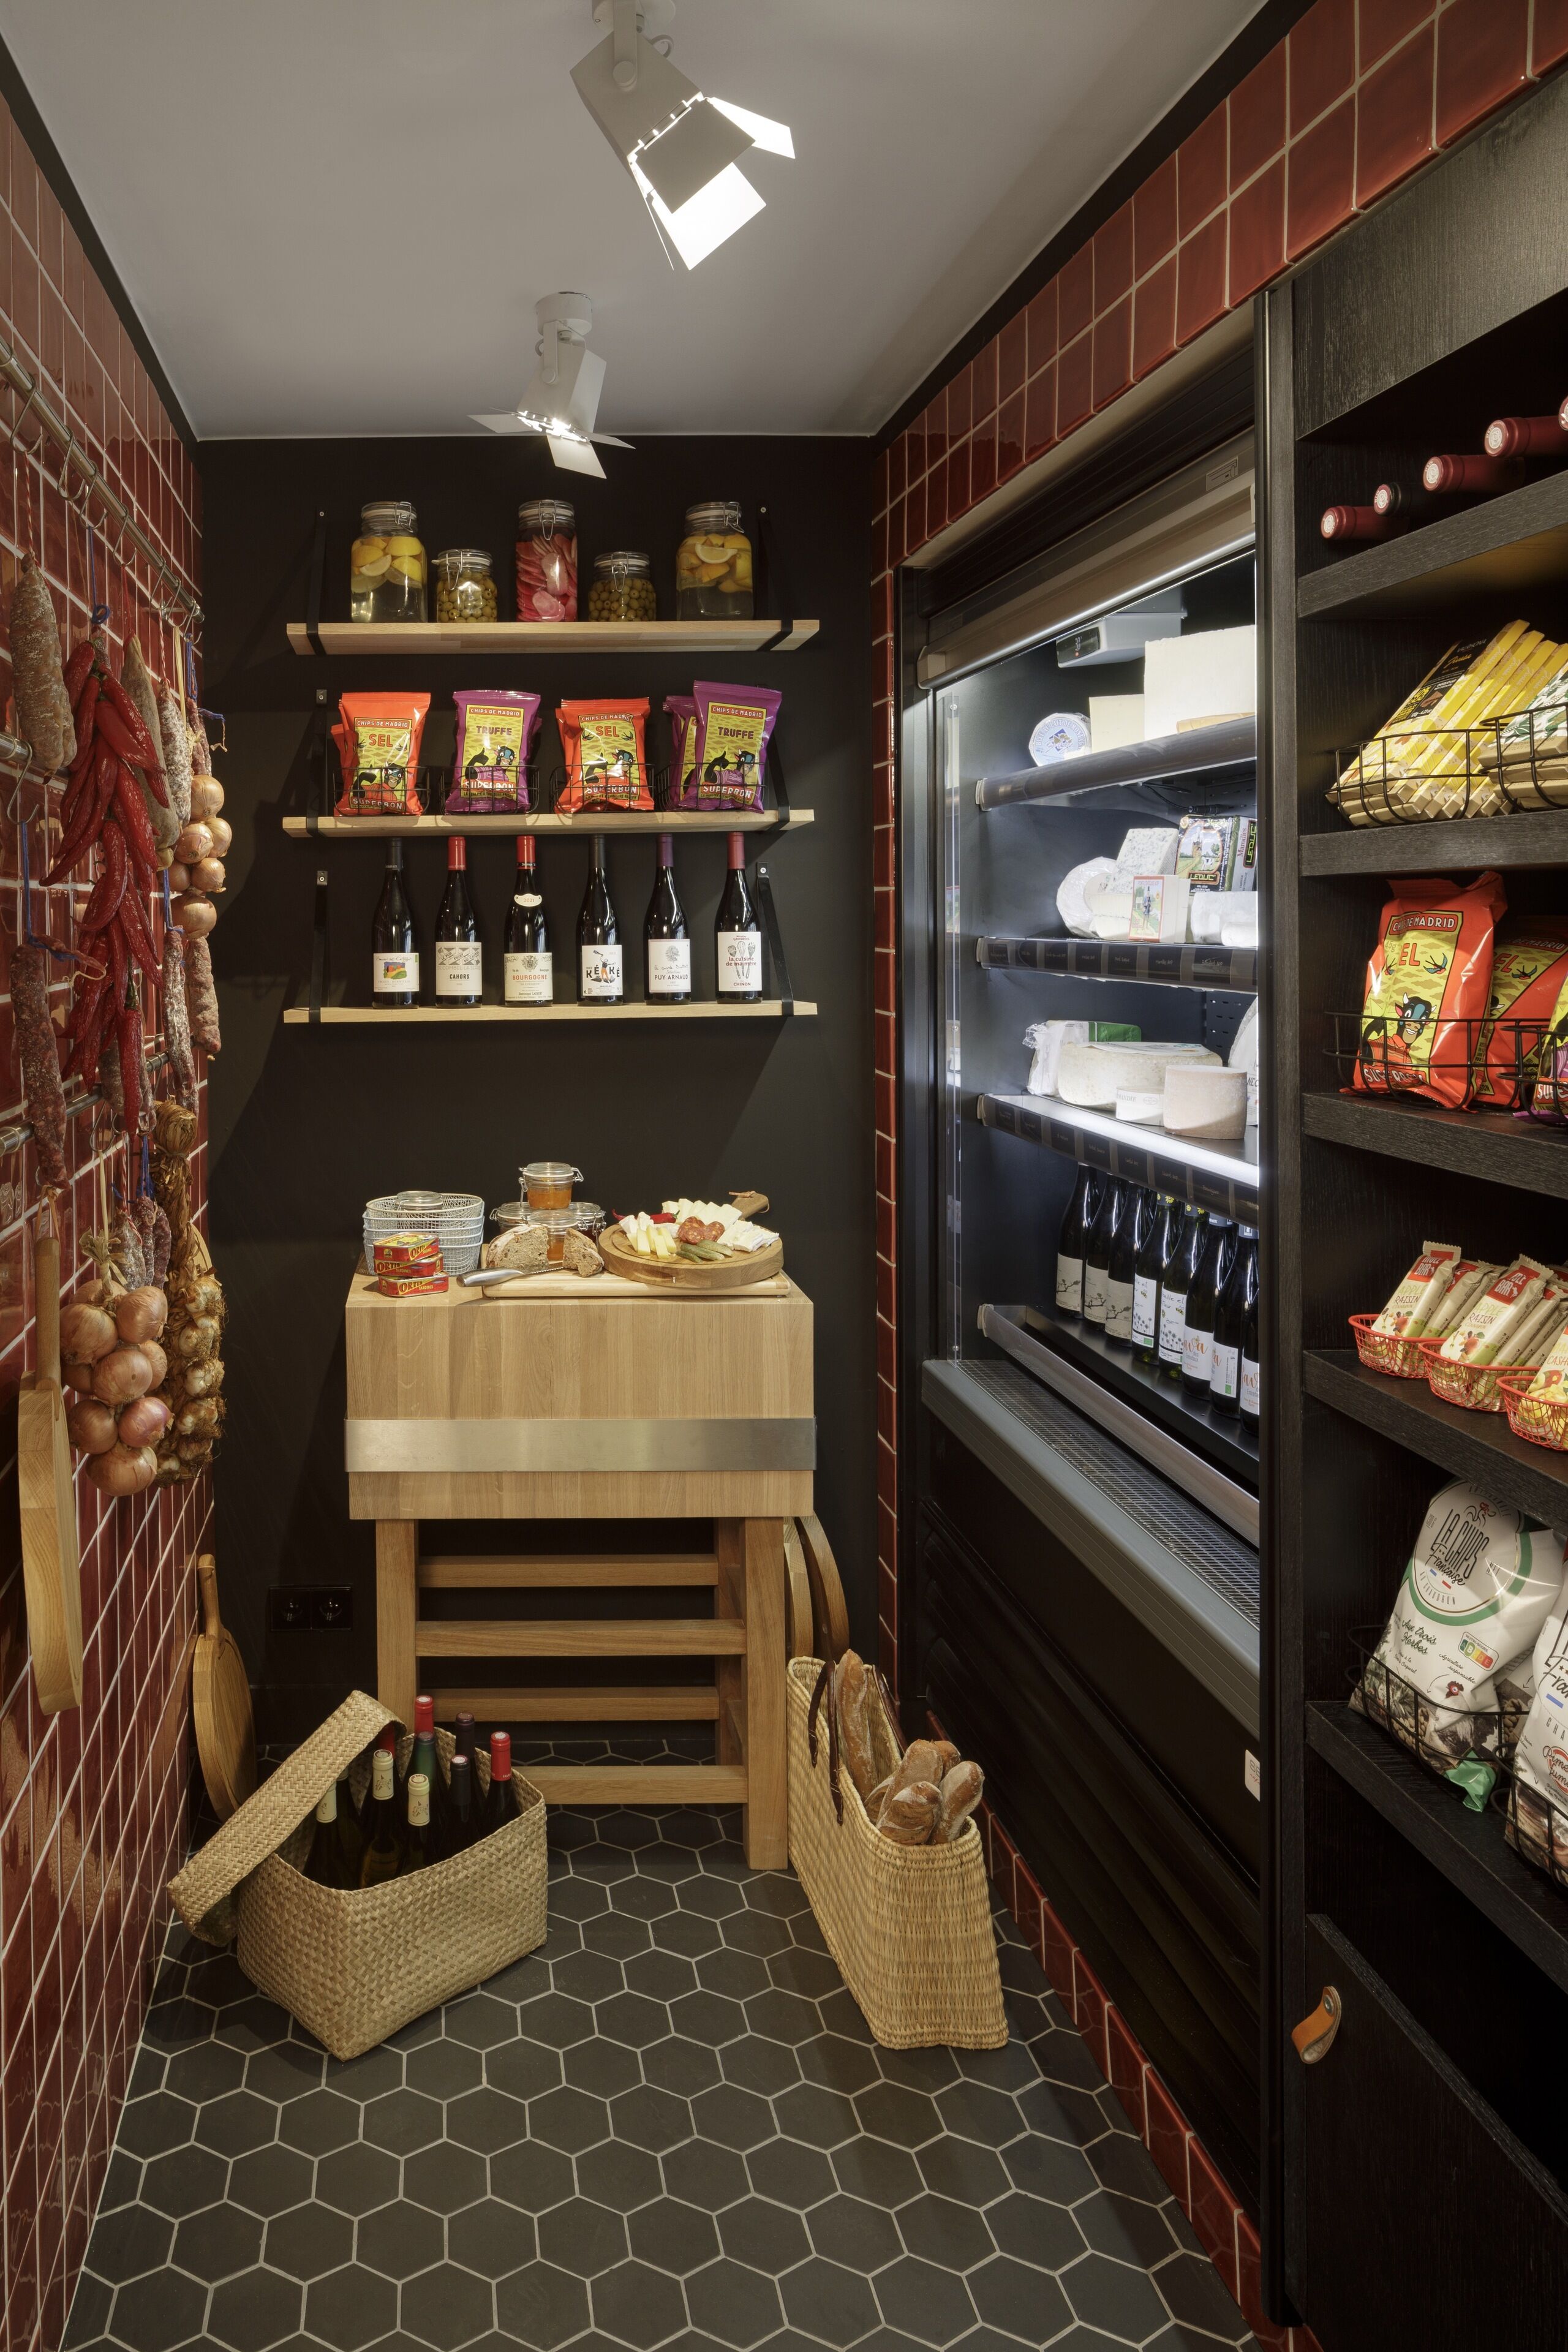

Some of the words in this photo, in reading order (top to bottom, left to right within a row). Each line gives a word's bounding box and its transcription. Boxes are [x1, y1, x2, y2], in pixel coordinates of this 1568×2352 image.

[476, 725, 512, 736] TRUFFE
[596, 726, 620, 737] SEL
[718, 726, 754, 739] TRUFFE
[369, 733, 393, 747] SEL
[703, 785, 752, 798] SUPERBON
[1237, 828, 1247, 858] Maroilles
[1246, 824, 1257, 863] LEDUC
[1414, 917, 1455, 928] MADRID
[1385, 941, 1396, 952] 45g
[1528, 940, 1565, 949] MADRID
[1398, 943, 1420, 966] EL
[1493, 952, 1519, 973] EL
[1414, 1263, 1431, 1276] BAR
[1494, 1279, 1514, 1296] BAR
[1394, 1295, 1422, 1304] RAISIN
[1475, 1302, 1509, 1316] APPLE
[1469, 1312, 1497, 1324] RAISIN
[1444, 1520, 1490, 1579] CHIPS
[1425, 1542, 1466, 1586] Française
[1415, 1626, 1437, 1645] trois
[1401, 1632, 1428, 1655] Herbes
[1465, 1634, 1489, 1653] NUTRI-SCORE
